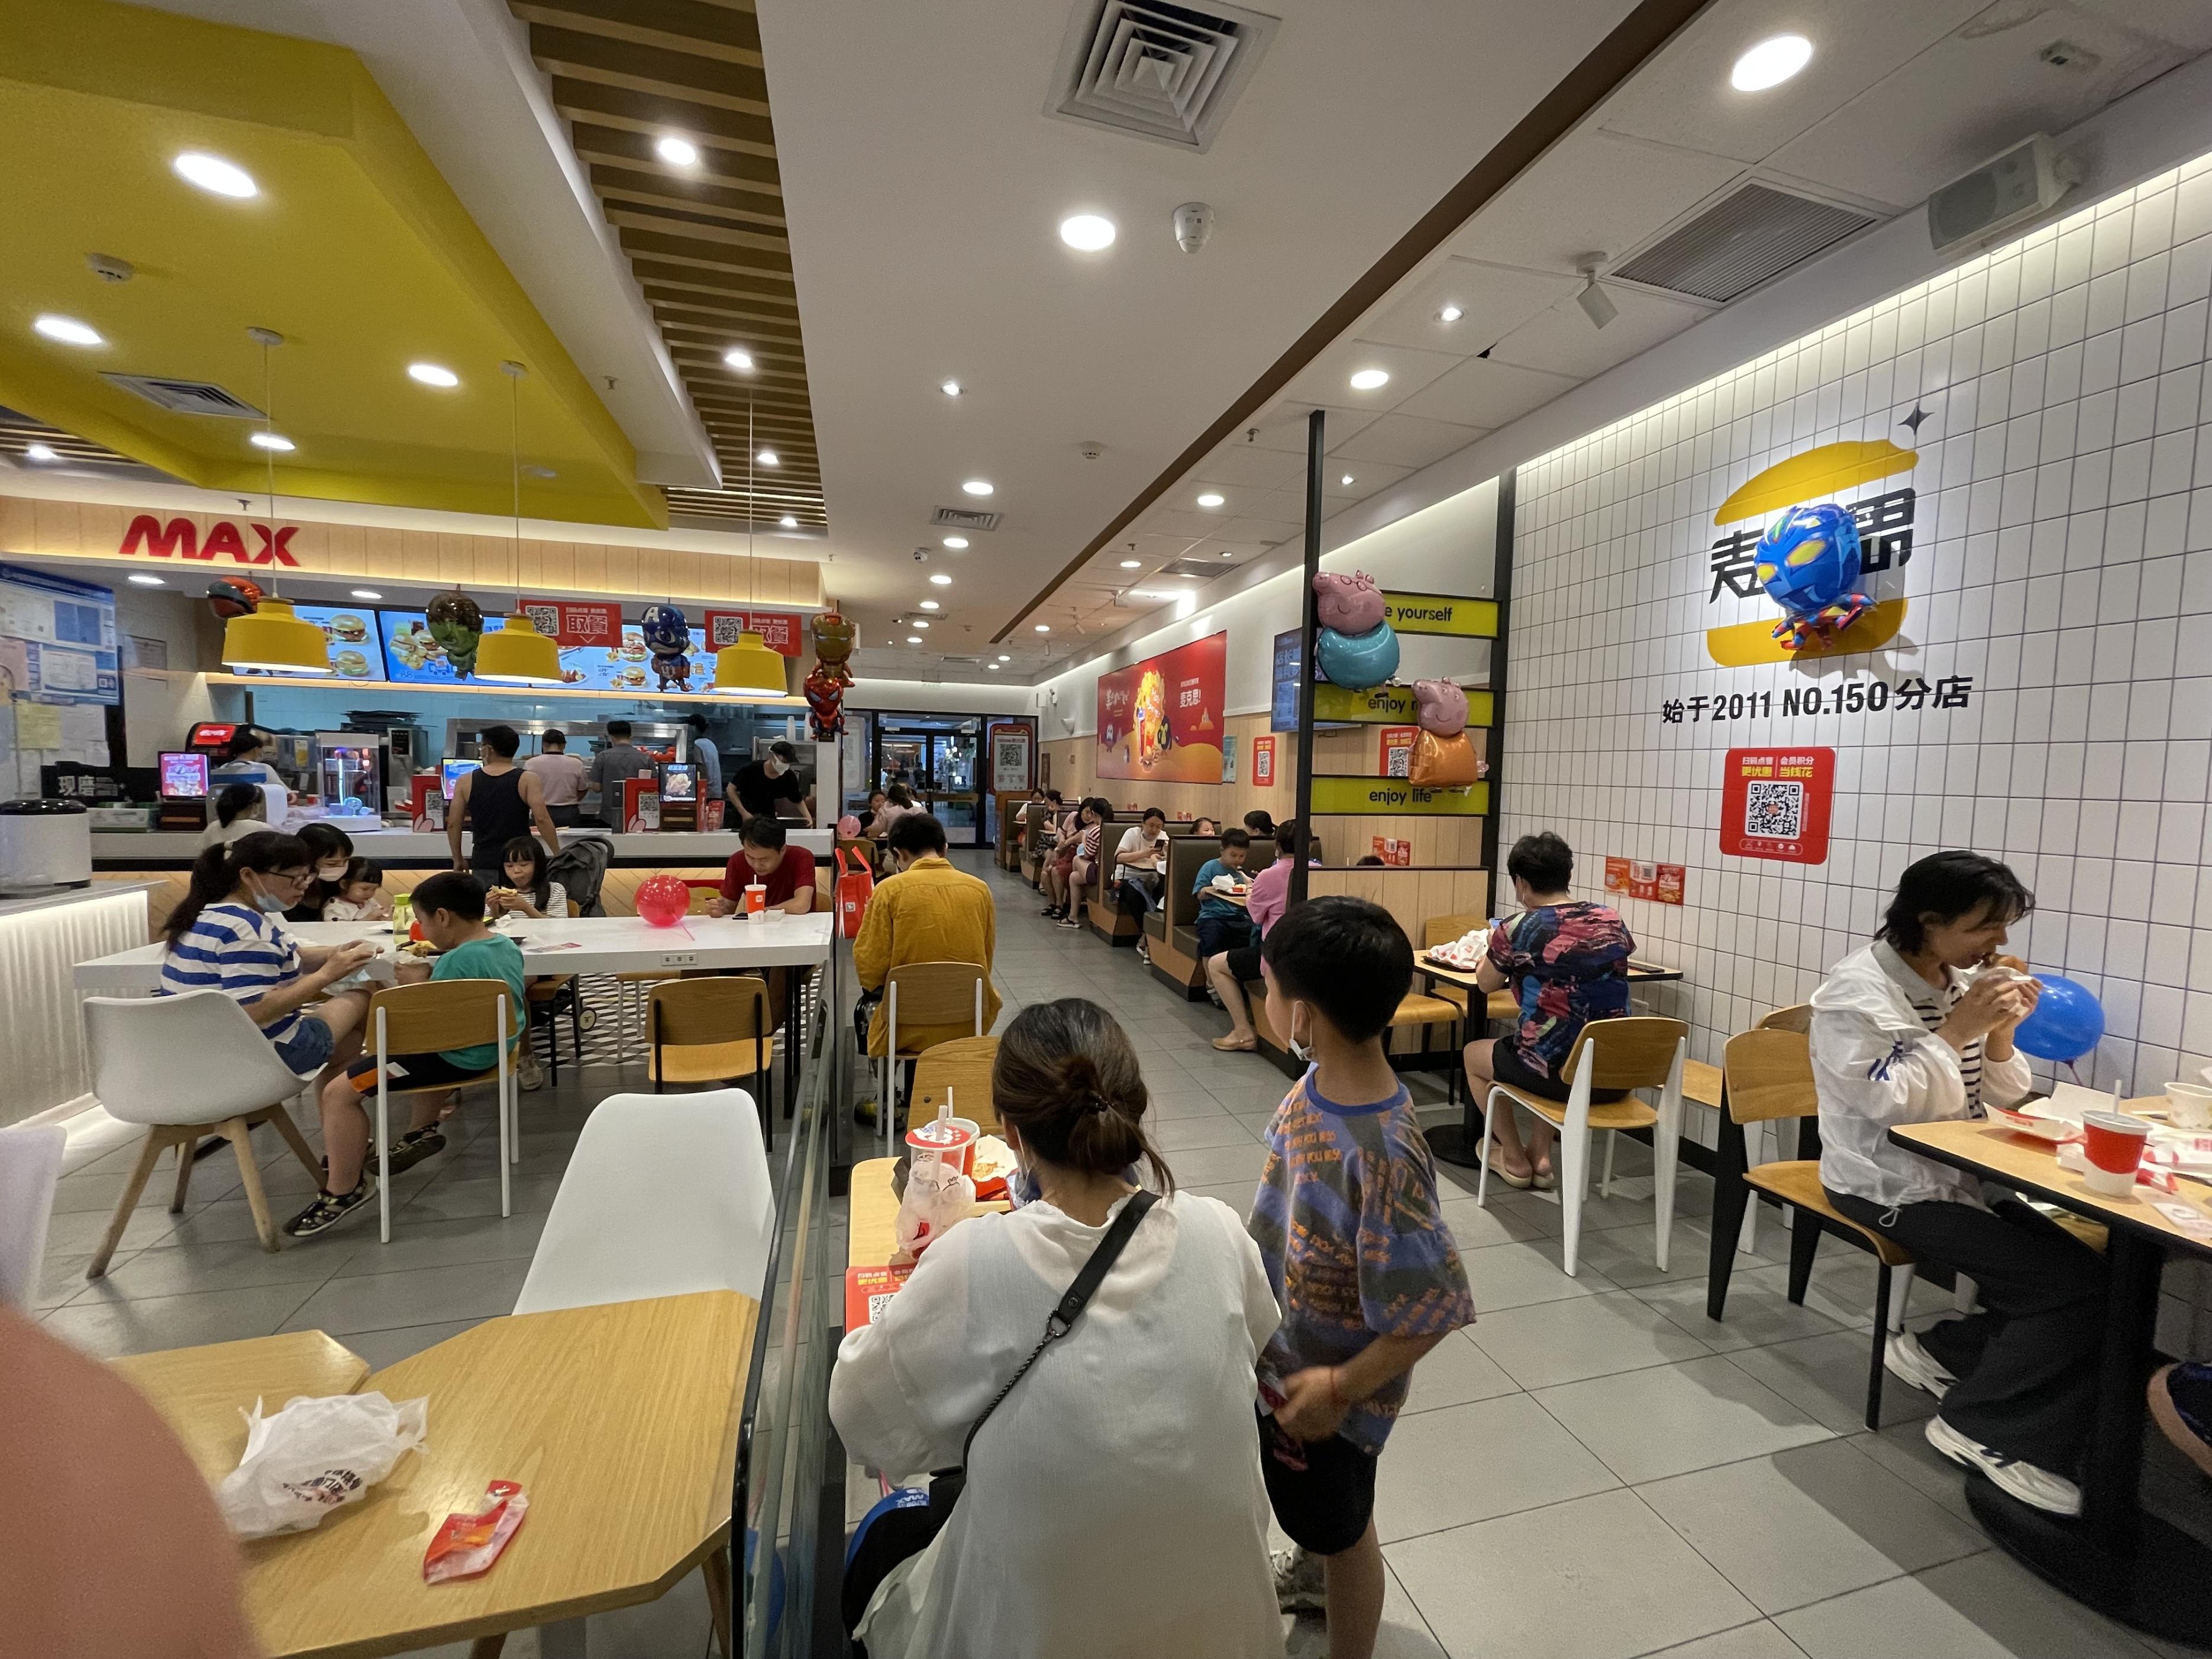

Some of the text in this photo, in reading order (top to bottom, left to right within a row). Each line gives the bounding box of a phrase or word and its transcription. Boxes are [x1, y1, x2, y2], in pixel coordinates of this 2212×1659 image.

[118, 514, 301, 567] MAX
[1397, 606, 1452, 621] yourself
[566, 614, 608, 634] 取餐
[1368, 695, 1406, 714] enjoy
[1662, 690, 1771, 724] 始于2011
[1780, 756, 1815, 765] 会员积分
[1741, 766, 1814, 777] 更优惠 当钱花
[1370, 787, 1432, 805] enjoy life
